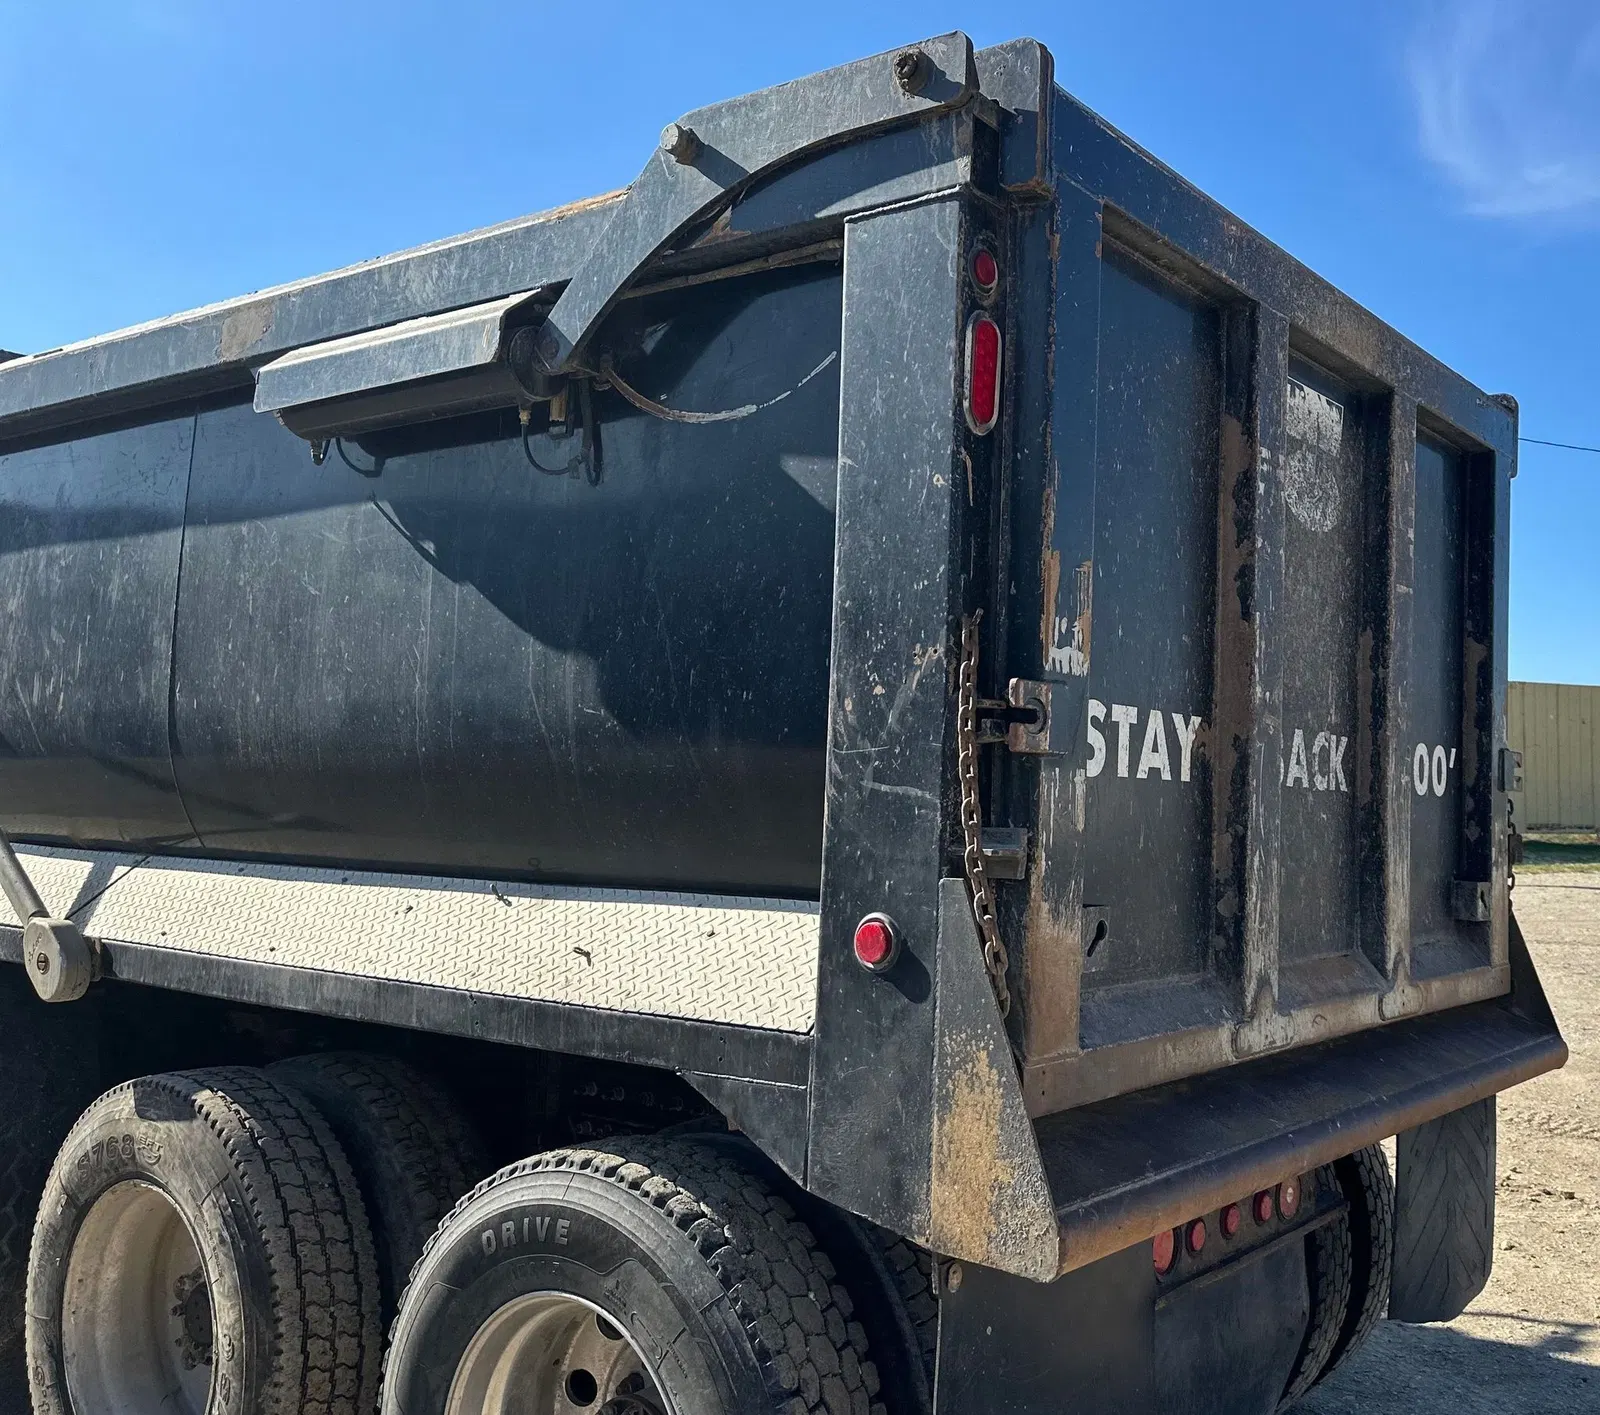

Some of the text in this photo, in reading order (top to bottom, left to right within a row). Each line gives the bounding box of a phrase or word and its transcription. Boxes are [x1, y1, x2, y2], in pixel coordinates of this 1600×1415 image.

[1086, 699, 1202, 782] STAY
[1280, 728, 1348, 792] ACK
[481, 1216, 571, 1255] DRIVE
